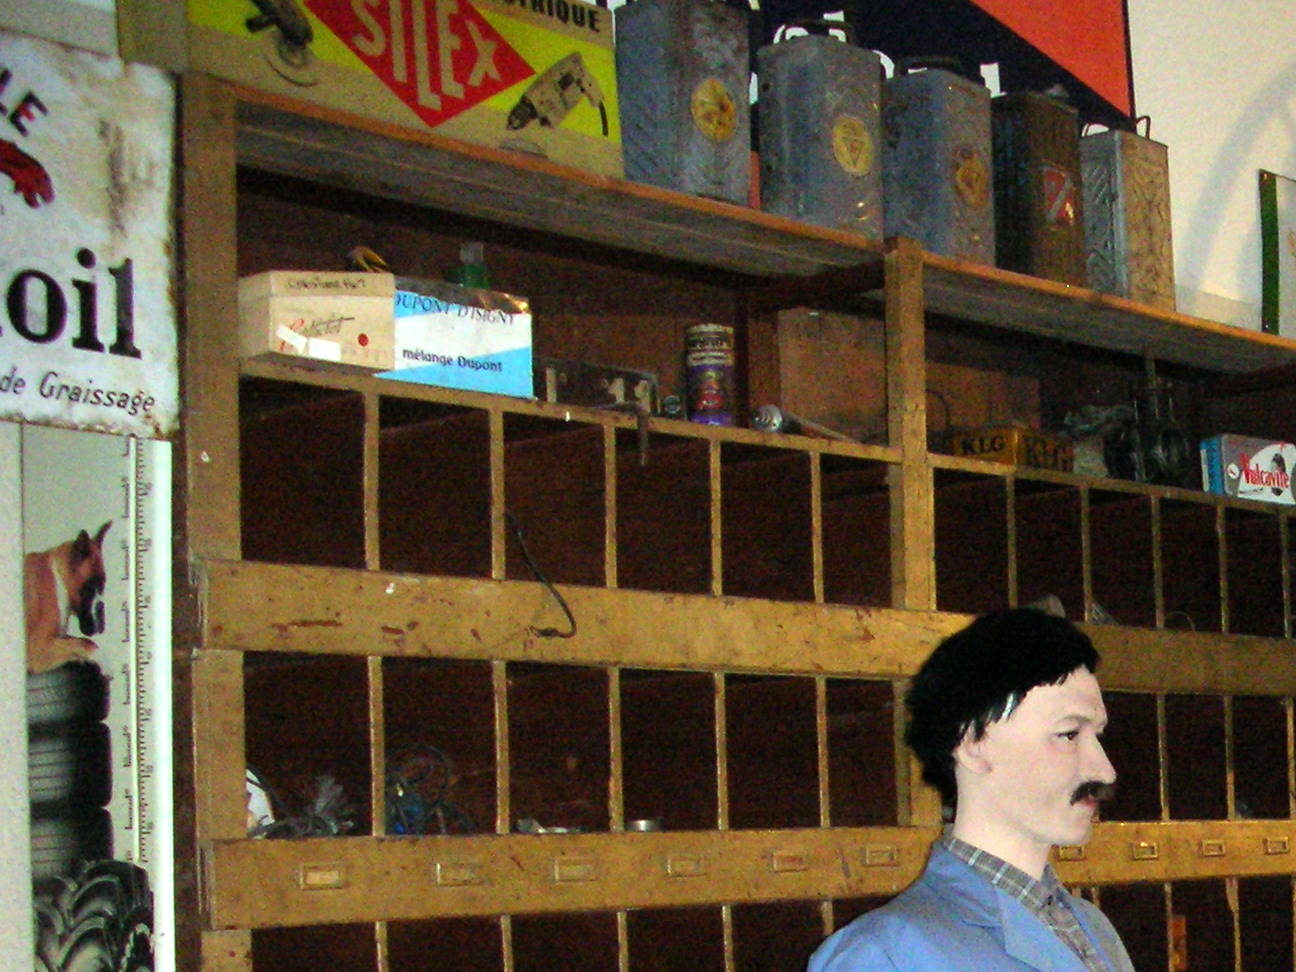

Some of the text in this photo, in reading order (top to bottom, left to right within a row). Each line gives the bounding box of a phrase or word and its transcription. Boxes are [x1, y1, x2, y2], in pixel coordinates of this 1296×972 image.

[350, 0, 502, 110] SILEX
[402, 347, 503, 373] mélange Dupont
[0, 364, 156, 416] de Graissage
